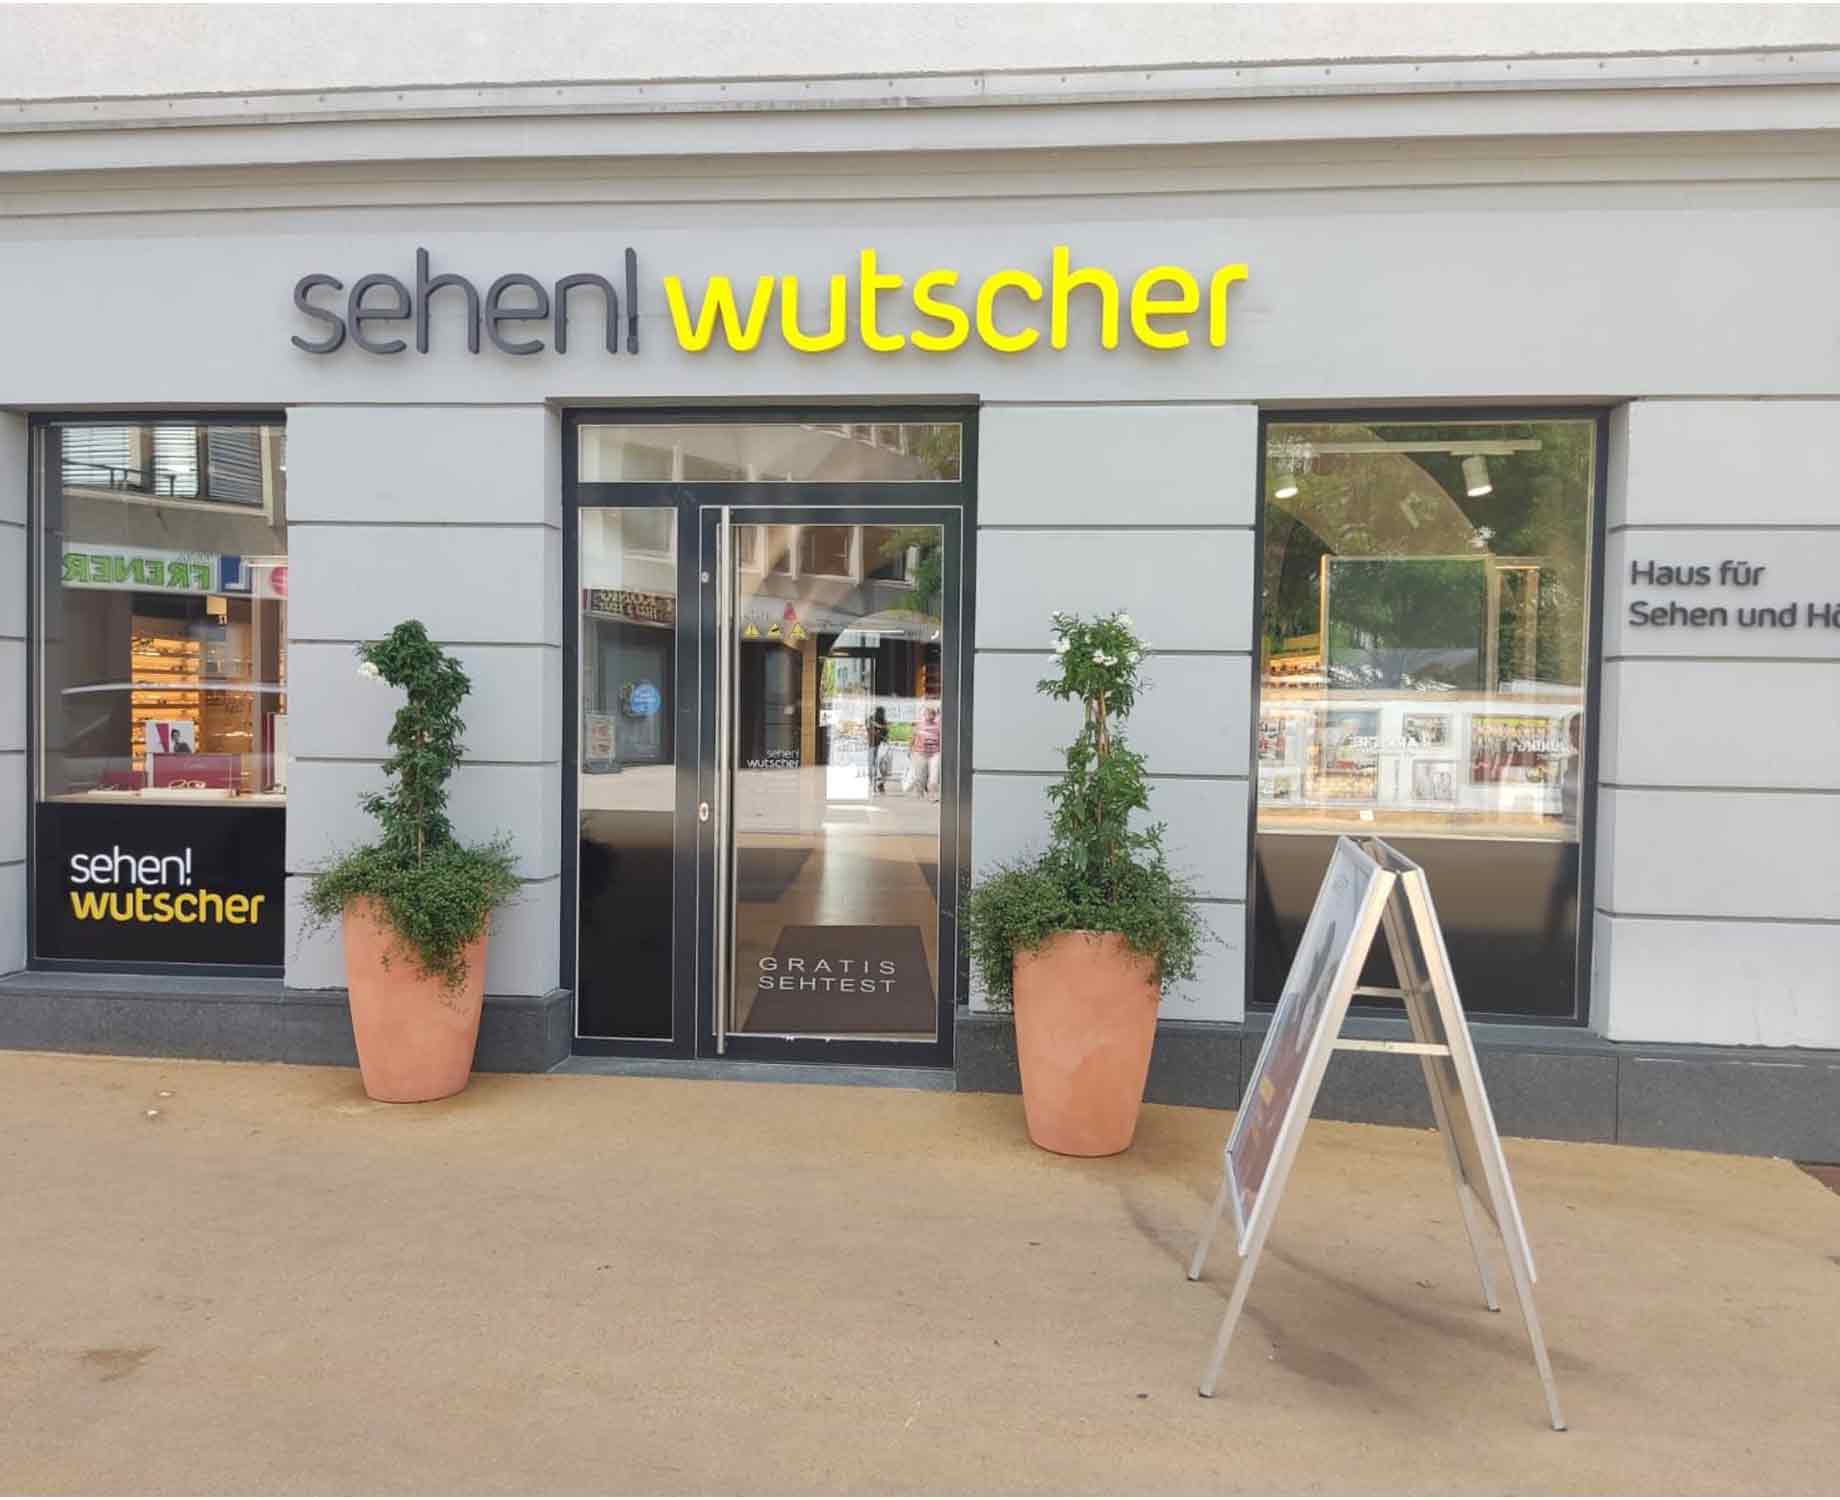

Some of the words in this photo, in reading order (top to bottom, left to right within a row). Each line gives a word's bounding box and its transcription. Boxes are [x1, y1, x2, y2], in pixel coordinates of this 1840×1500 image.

[664, 246, 1249, 353] wutscher
[1631, 560, 1711, 587] Haus
[1719, 560, 1766, 587] für
[1629, 601, 1728, 628] Sehen
[1737, 602, 1798, 629] und
[70, 846, 192, 886] sehen!
[70, 887, 265, 925] wutscher
[759, 957, 896, 975] GRATIS
[758, 975, 897, 993] SEHTEST
